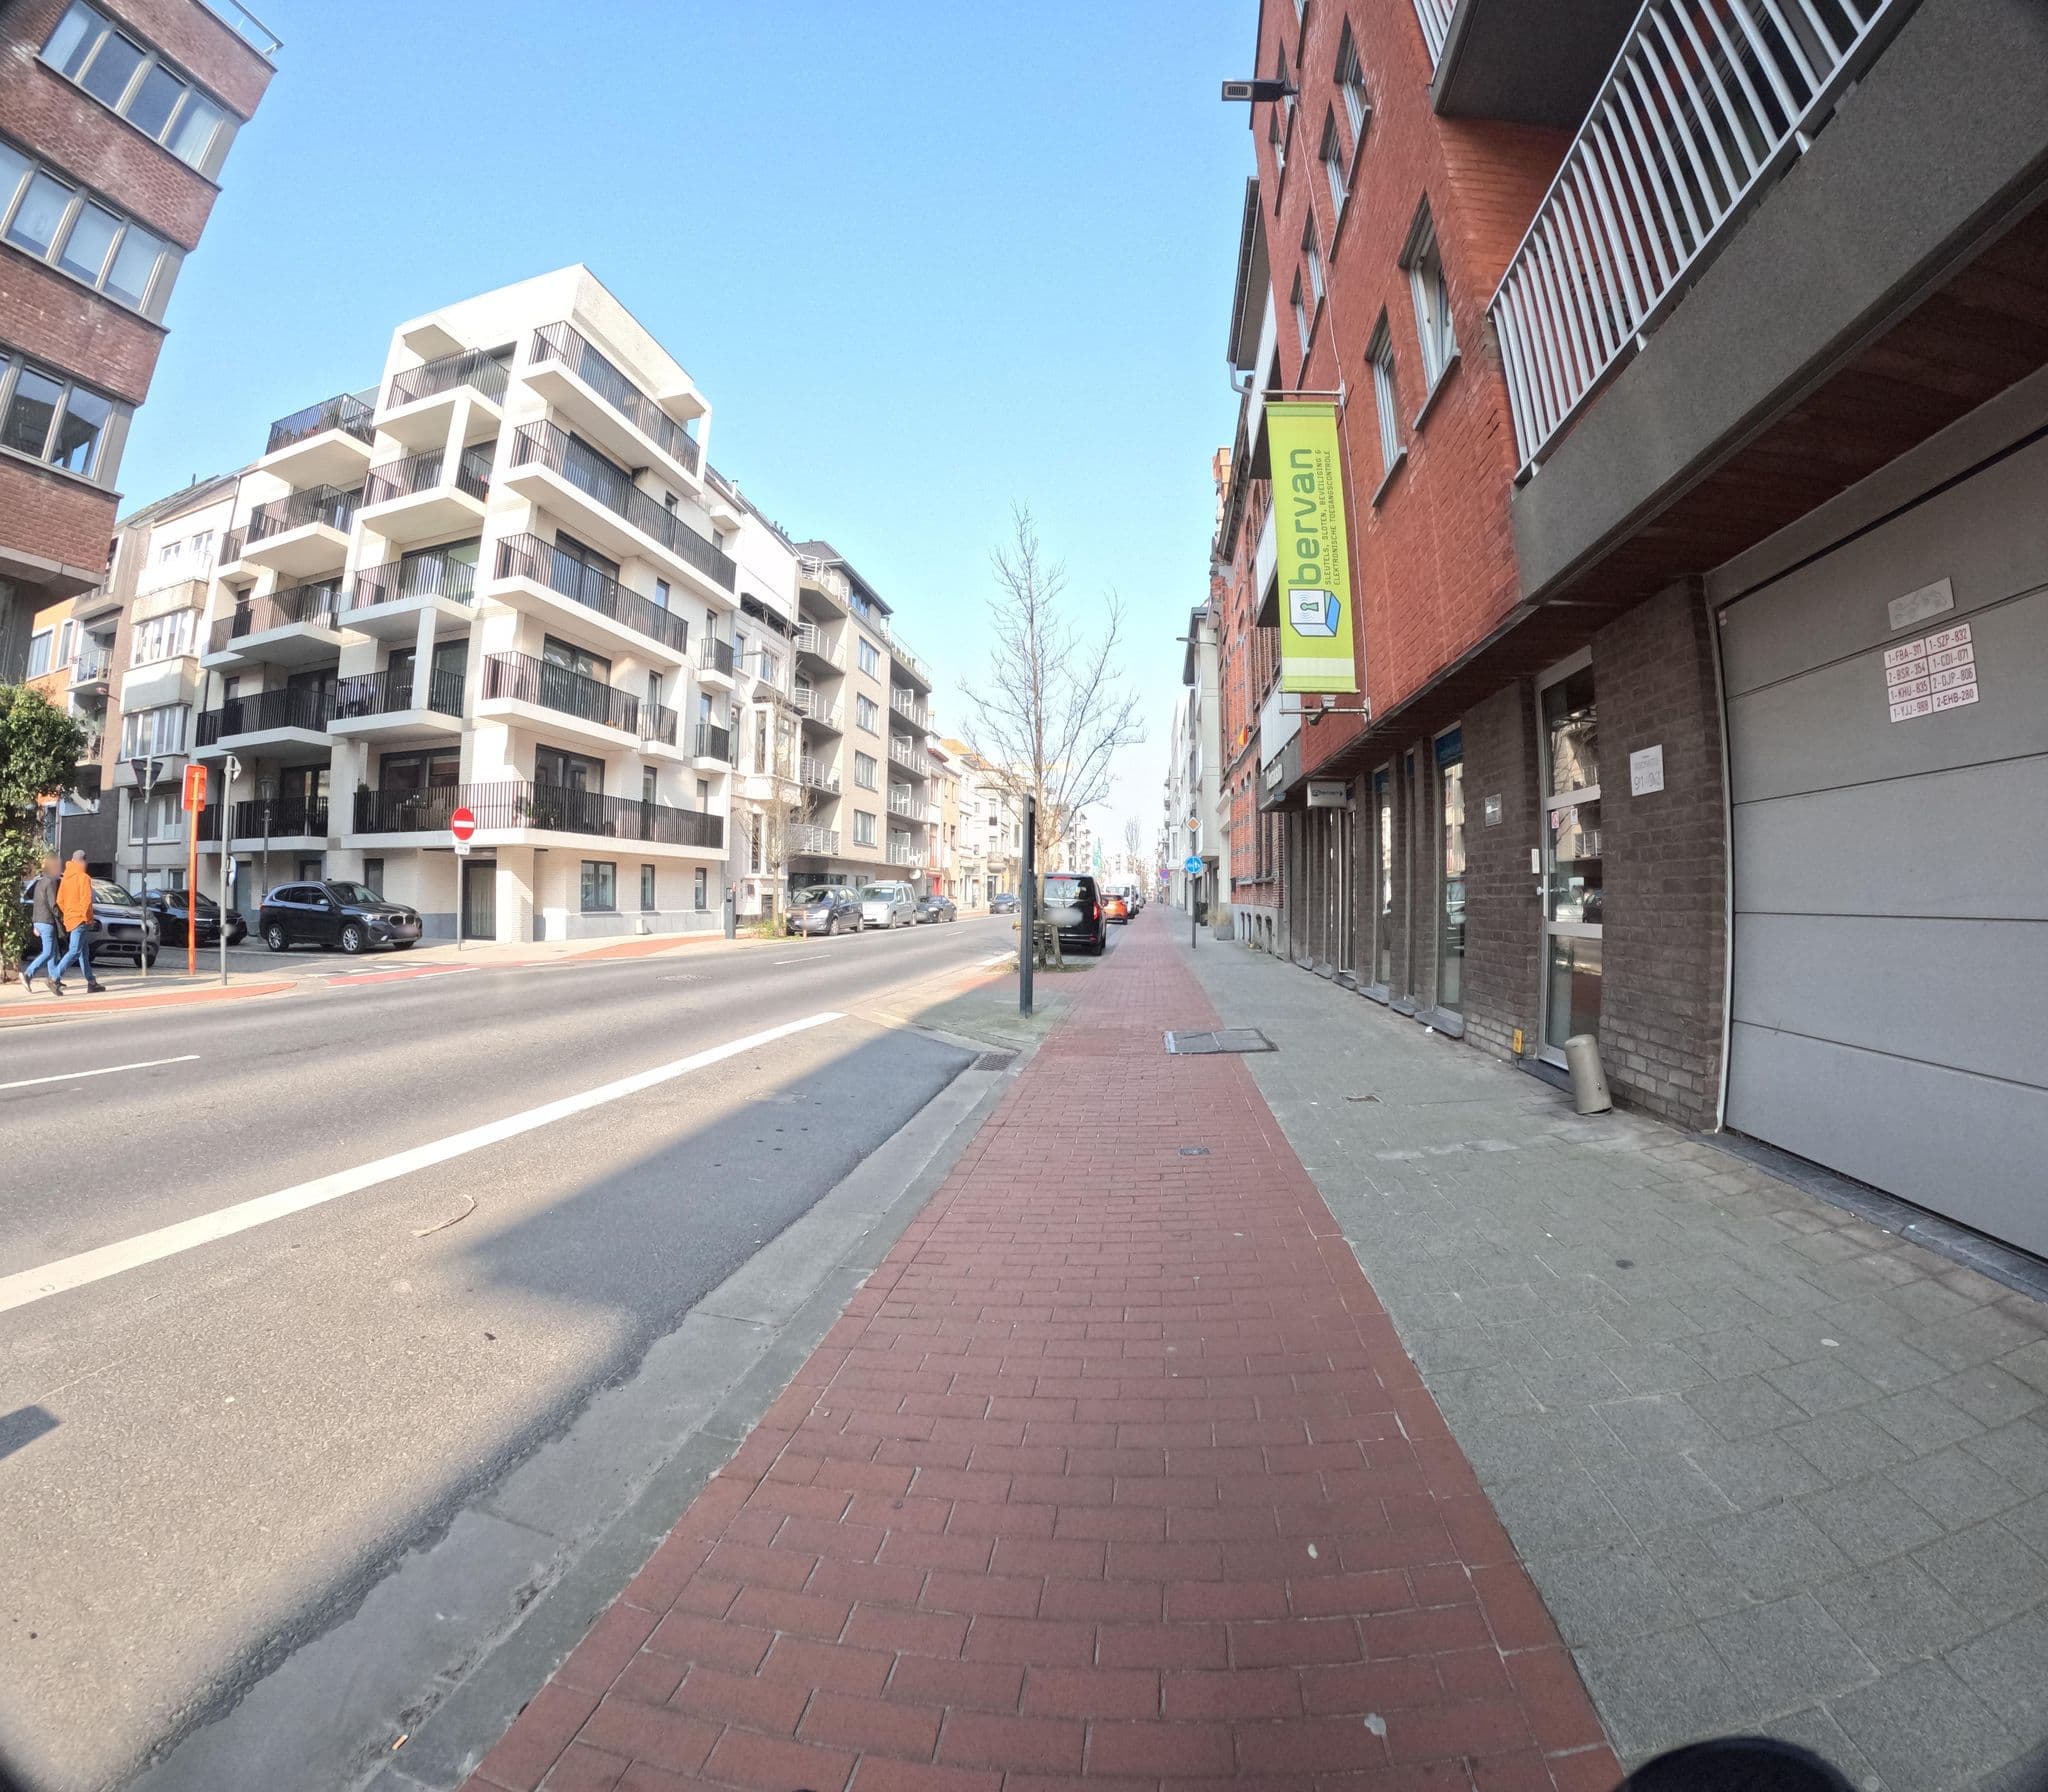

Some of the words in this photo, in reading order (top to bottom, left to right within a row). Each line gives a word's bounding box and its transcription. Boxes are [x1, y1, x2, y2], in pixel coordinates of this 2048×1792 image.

[1316, 457, 1326, 506] BEVEILIGING
[1288, 449, 1322, 585] bervan
[1322, 544, 1331, 586] SLEUTELS,
[1330, 525, 1341, 586] ELEKTRONISCHE
